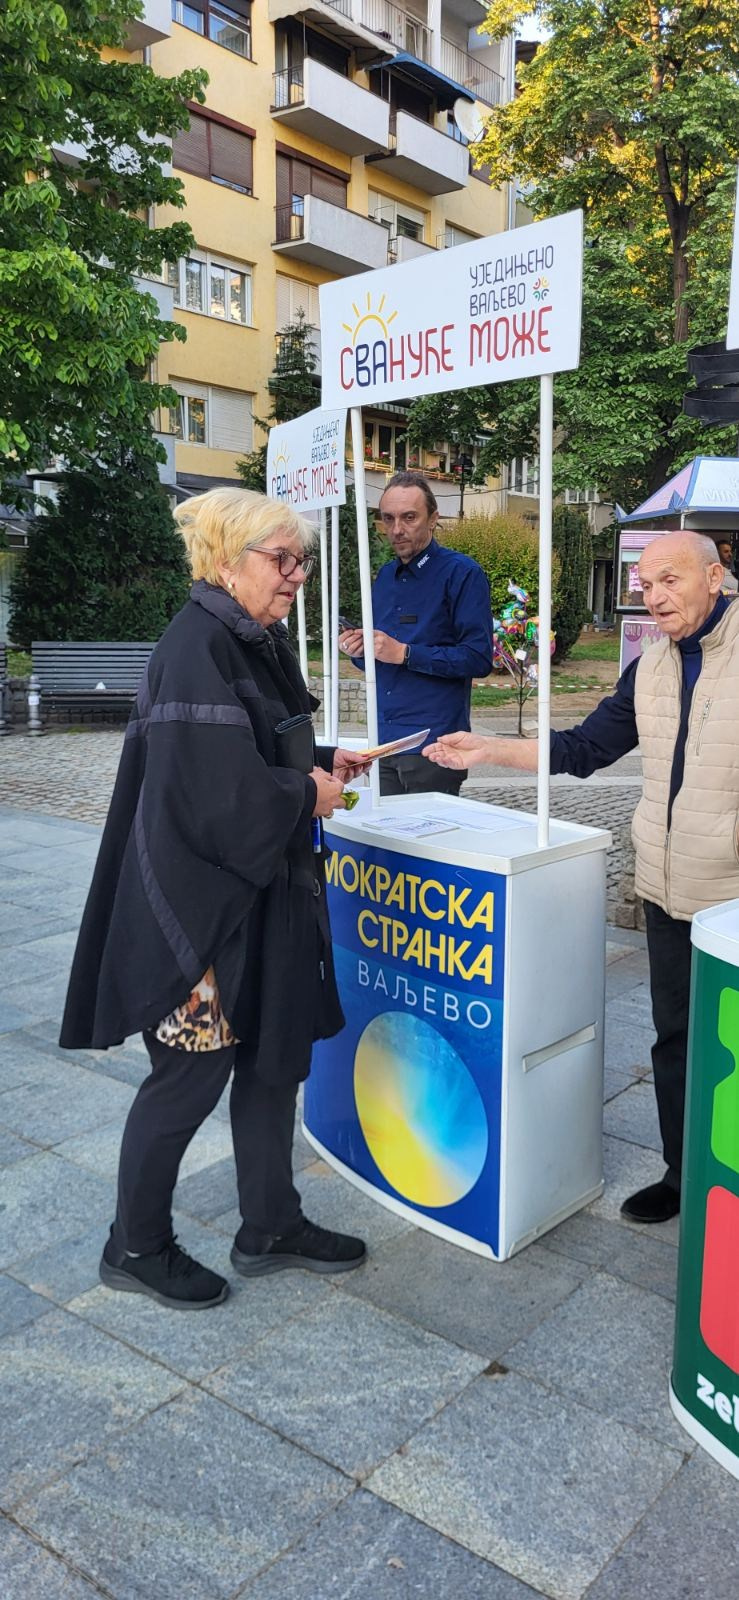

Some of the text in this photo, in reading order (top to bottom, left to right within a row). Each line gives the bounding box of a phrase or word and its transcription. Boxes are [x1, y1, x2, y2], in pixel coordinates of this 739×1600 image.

[470, 245, 554, 288] УЈЕДИЊЕНО
[470, 282, 526, 317] ВАЉЕВО
[340, 306, 553, 390] СВАНУЋЕ МОЖЕ
[311, 461, 339, 499] МОЖЕ
[357, 909, 494, 985] СТРАНКА
[358, 959, 492, 1029] ВАЉЕВО
